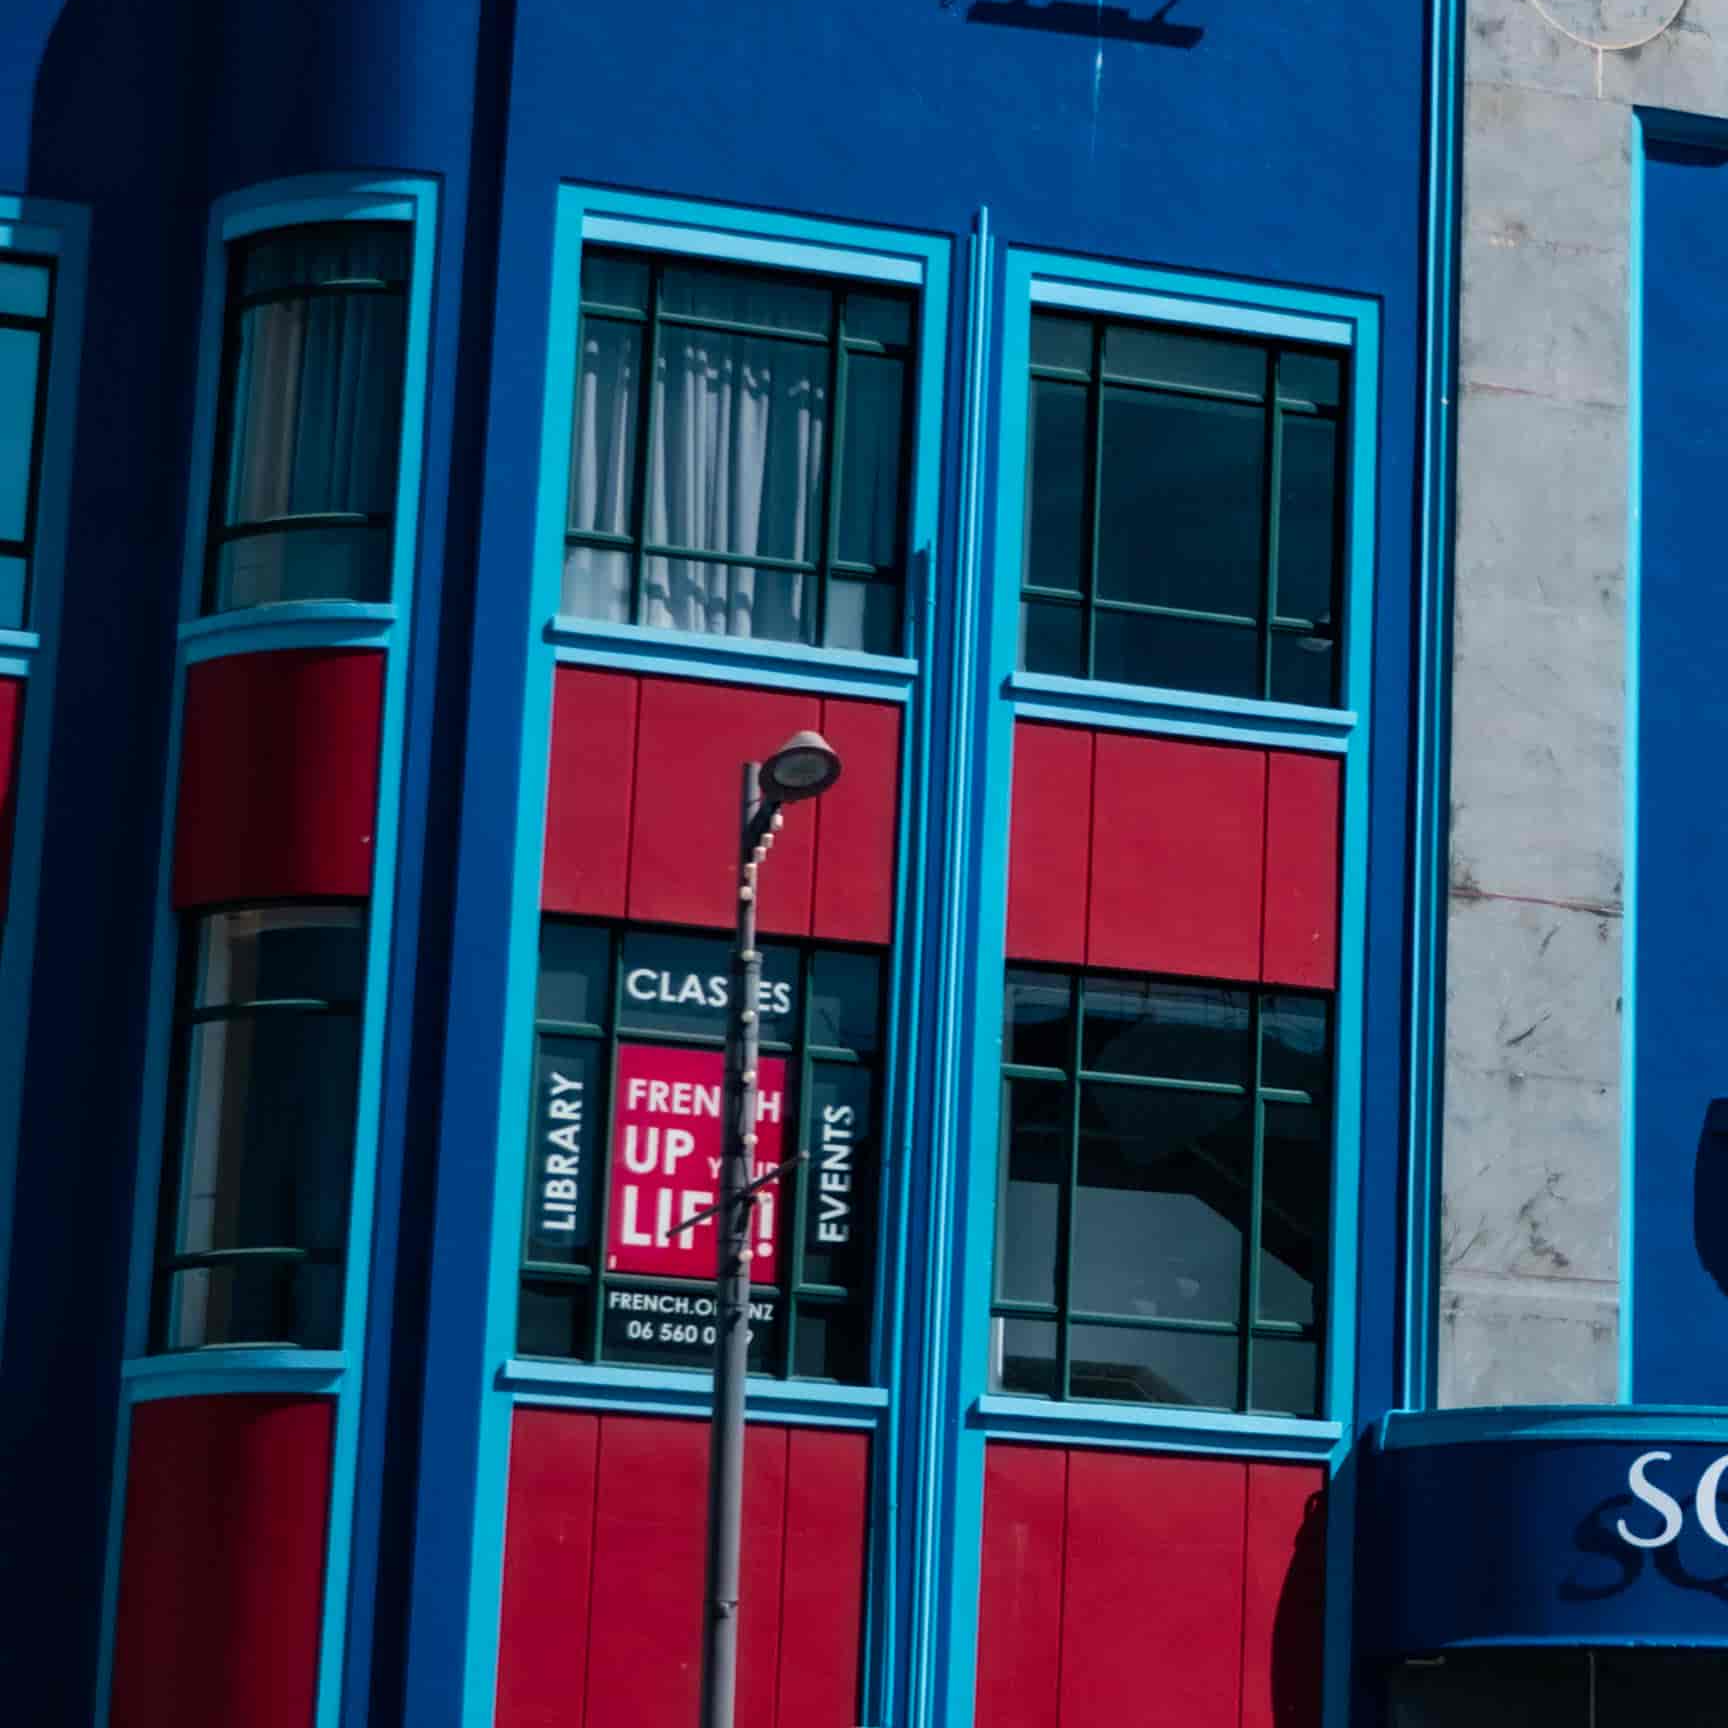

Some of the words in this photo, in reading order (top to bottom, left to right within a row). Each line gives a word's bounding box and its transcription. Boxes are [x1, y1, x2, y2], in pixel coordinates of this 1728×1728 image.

[626, 968, 791, 1014] CLASES
[627, 1078, 781, 1123] FRENH
[542, 1072, 584, 1232] LIBRARY
[624, 1125, 695, 1175] UP
[707, 1156, 779, 1184] YUR
[818, 1104, 855, 1243] EVENTS
[621, 1185, 775, 1257] LIF!
[627, 1320, 653, 1340] 06
[659, 1323, 698, 1343] 560
